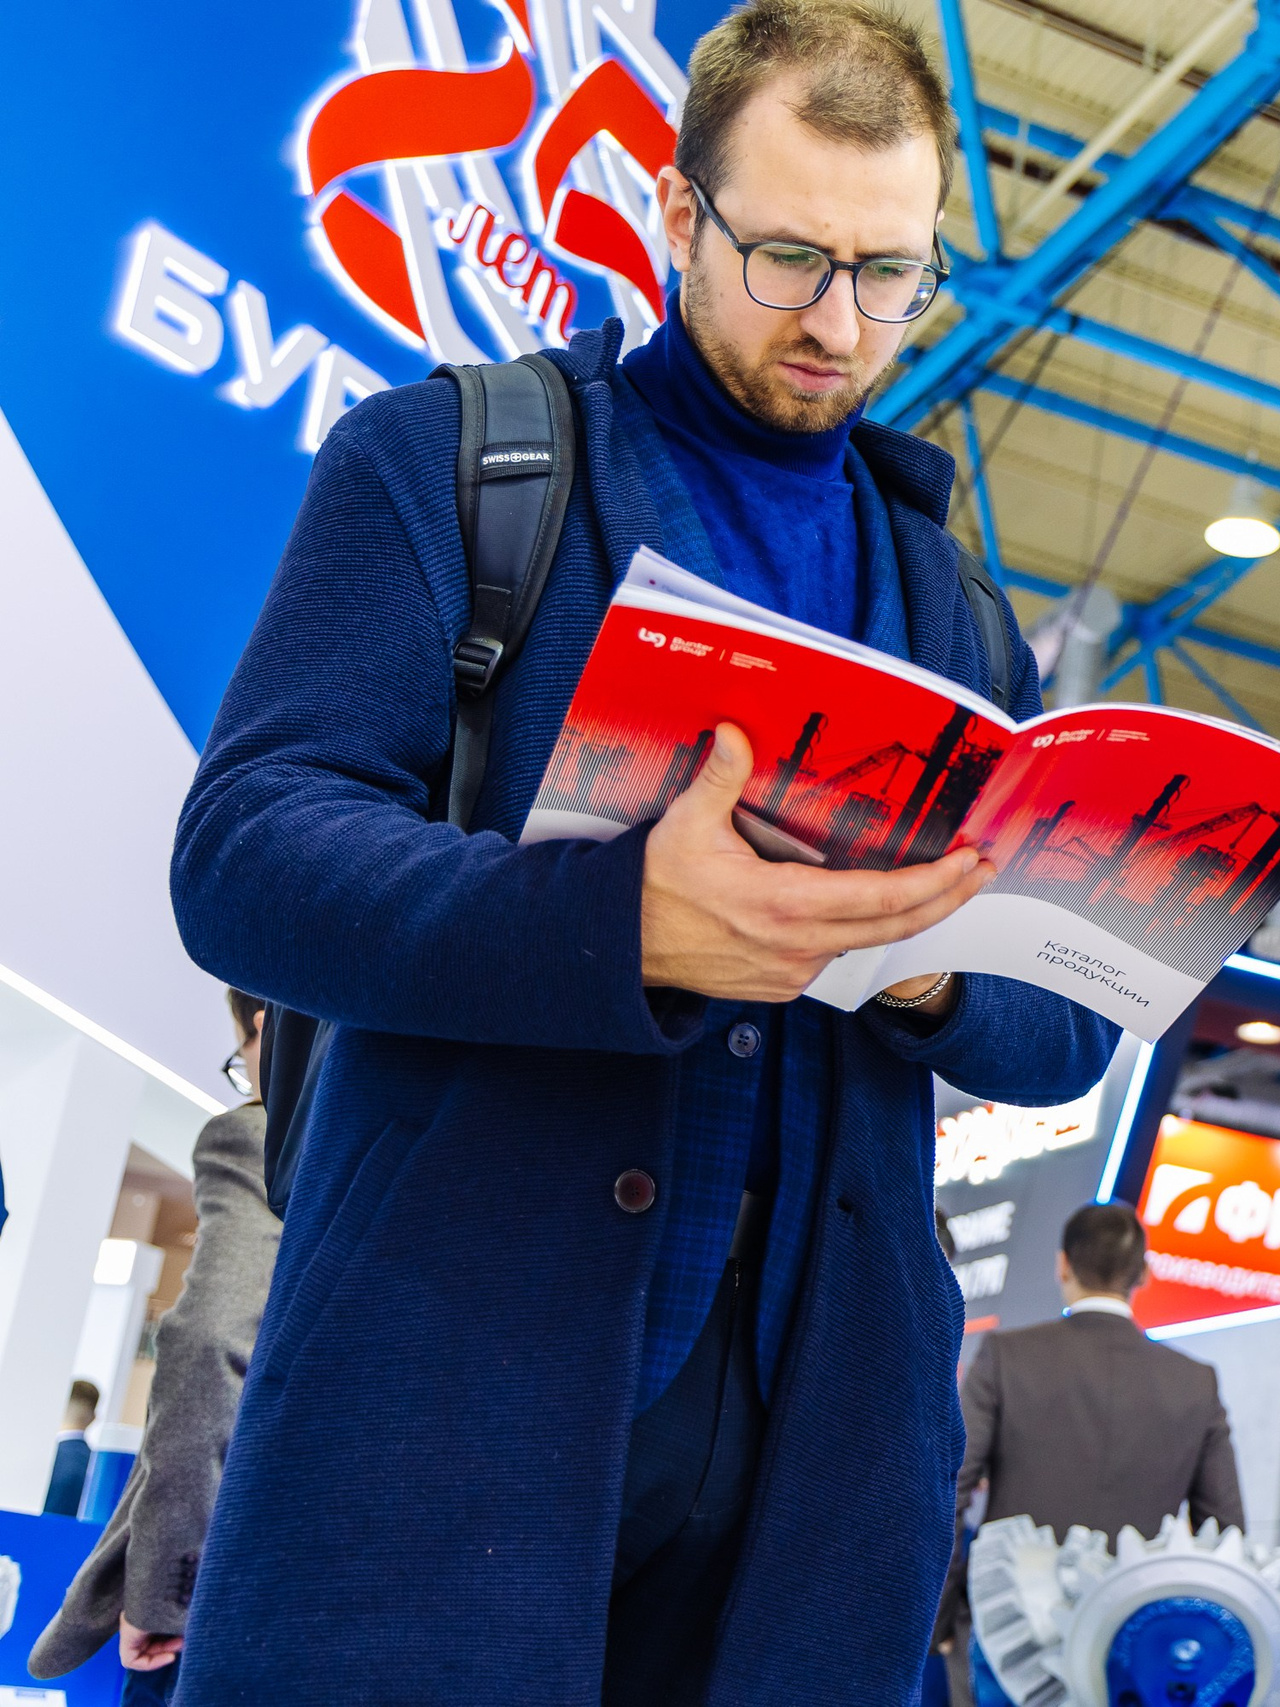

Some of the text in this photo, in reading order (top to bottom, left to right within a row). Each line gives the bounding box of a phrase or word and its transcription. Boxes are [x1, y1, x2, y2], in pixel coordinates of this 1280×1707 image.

[482, 452, 550, 465] SWISS GEAR
[1044, 940, 1127, 977] Каталог
[1036, 951, 1150, 1008] продукции
